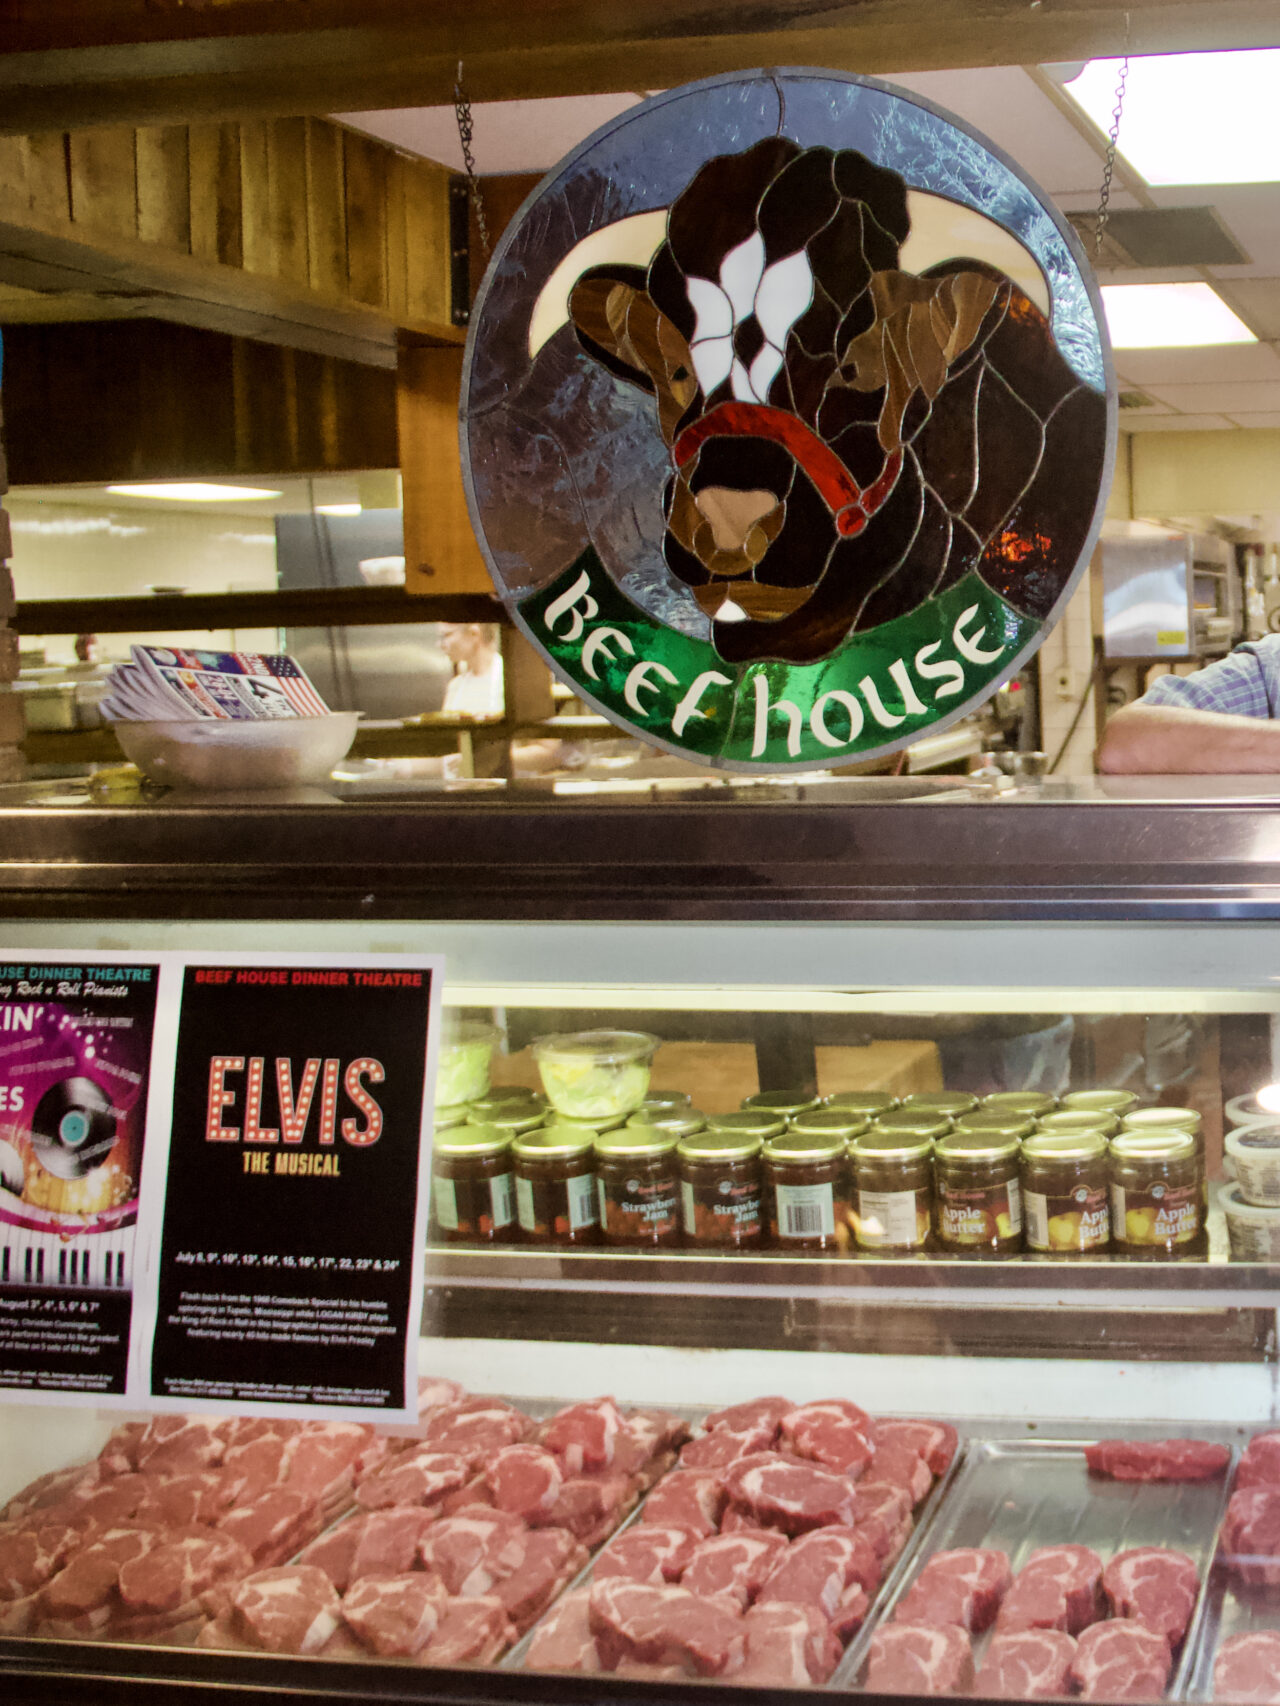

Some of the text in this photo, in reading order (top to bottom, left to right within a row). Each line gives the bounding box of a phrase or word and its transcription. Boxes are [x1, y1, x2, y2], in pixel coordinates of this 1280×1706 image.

[29, 967, 83, 981] DINNER
[87, 967, 152, 982] THEATRE
[195, 970, 423, 987] BEEF HOUSE DINNER THEATRE
[16, 981, 44, 995] Rock
[56, 981, 80, 995] Roll
[83, 982, 129, 997] Pianists
[0, 1005, 45, 1031] IN'
[205, 1055, 386, 1147] ELVIS
[242, 1151, 341, 1177] THE MUSICAL
[642, 1210, 668, 1222] Jam
[943, 1205, 981, 1222] Apple
[1156, 1202, 1196, 1222] Apple
[175, 1251, 196, 1265] July
